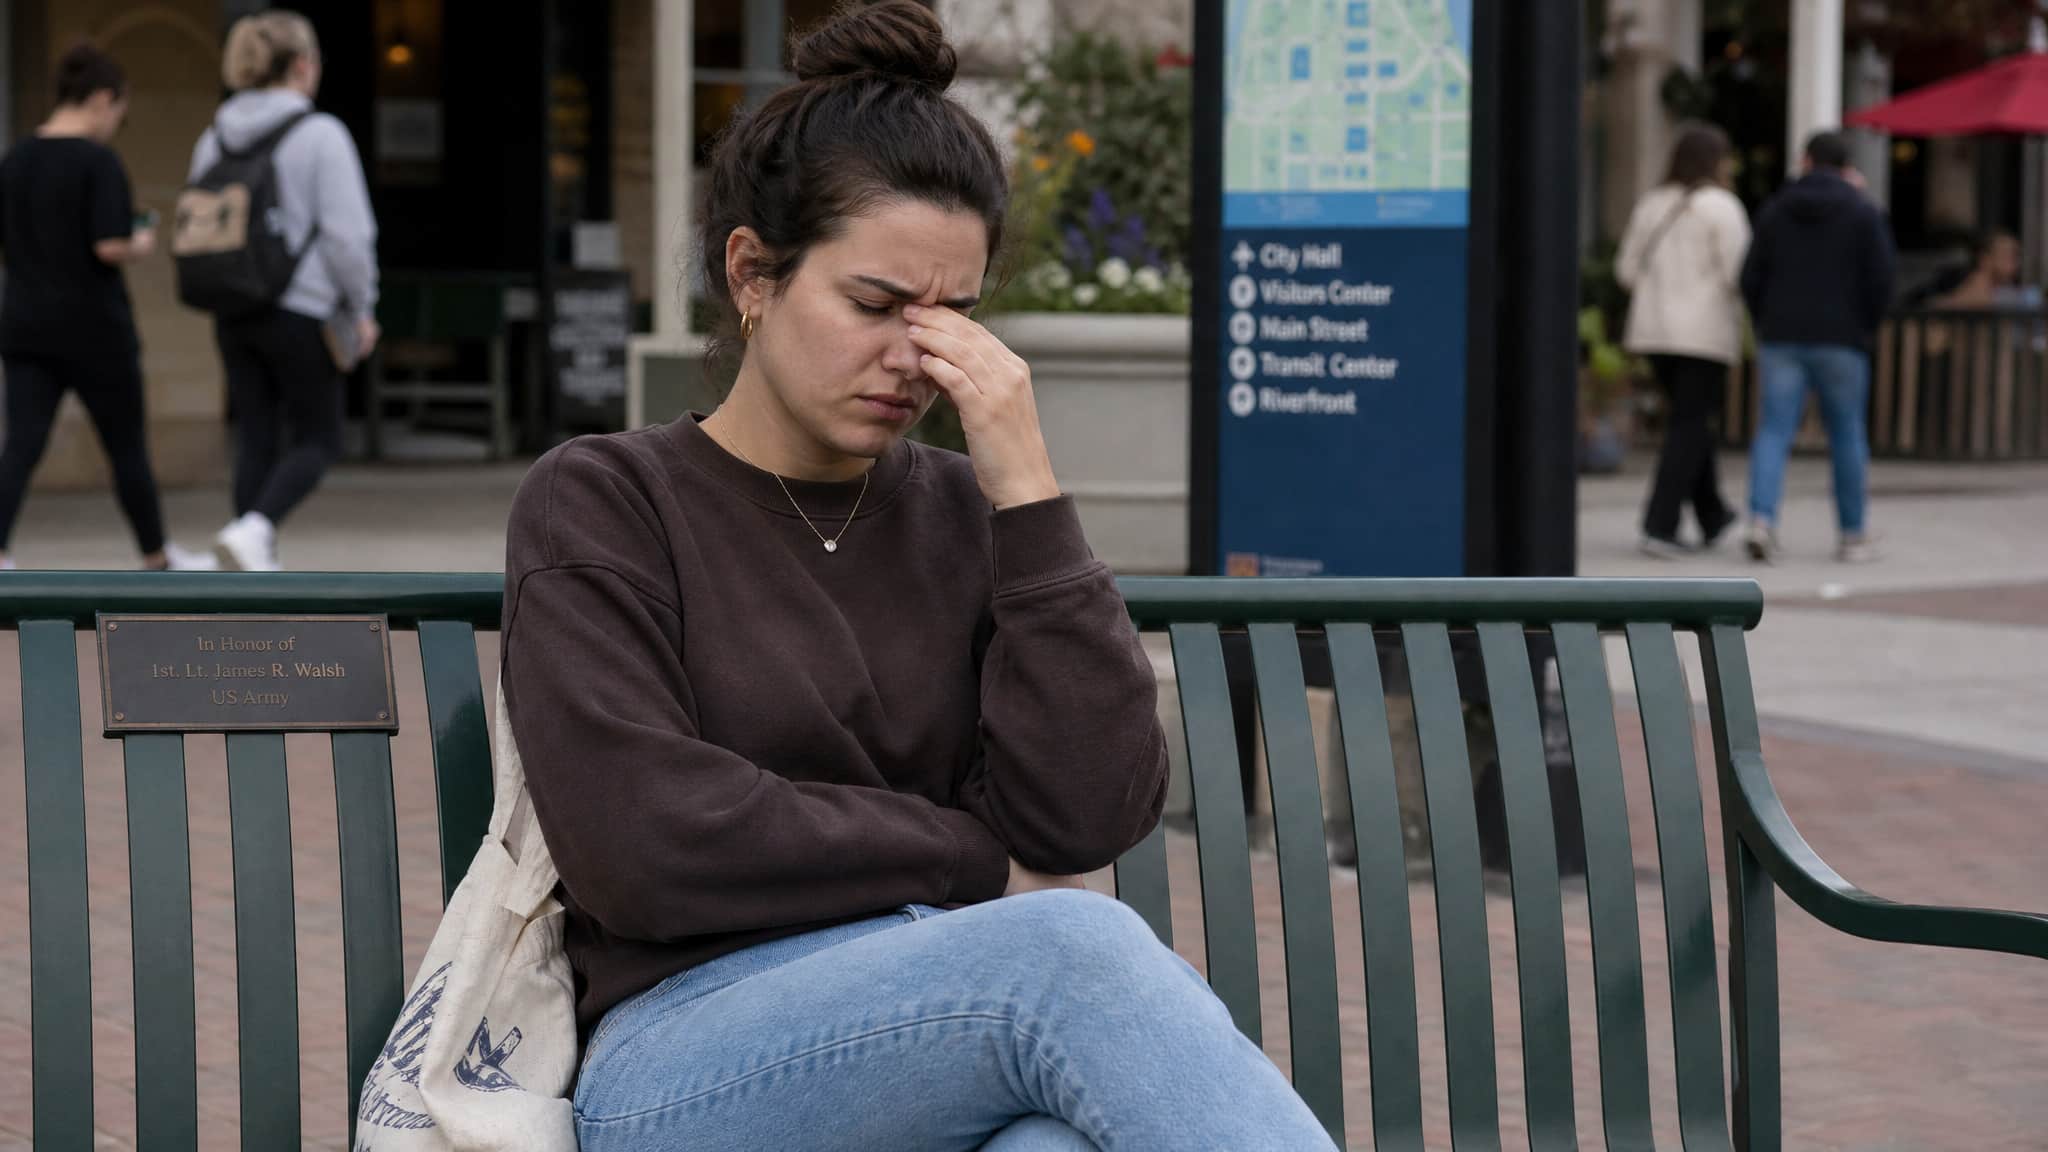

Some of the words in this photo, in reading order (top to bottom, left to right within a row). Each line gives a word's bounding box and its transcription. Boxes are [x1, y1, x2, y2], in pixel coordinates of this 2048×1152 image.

[1259, 243, 1299, 274] City
[1302, 243, 1343, 268] Hall
[1259, 279, 1327, 305] Visitors
[1328, 279, 1393, 305] Center
[1259, 316, 1307, 341] Main
[1308, 316, 1369, 342] Street
[1259, 351, 1326, 377] Transit
[1329, 352, 1399, 379] Center
[1259, 386, 1357, 414] Riverfront
[197, 636, 215, 651] In
[221, 636, 273, 651] Honor
[278, 636, 296, 651] of
[152, 663, 180, 678] 1st.
[186, 663, 208, 678] Lt.
[215, 663, 265, 680] James
[272, 663, 289, 678] R.
[295, 662, 345, 678] Walsh
[211, 689, 238, 705] US
[243, 689, 290, 708] Army
